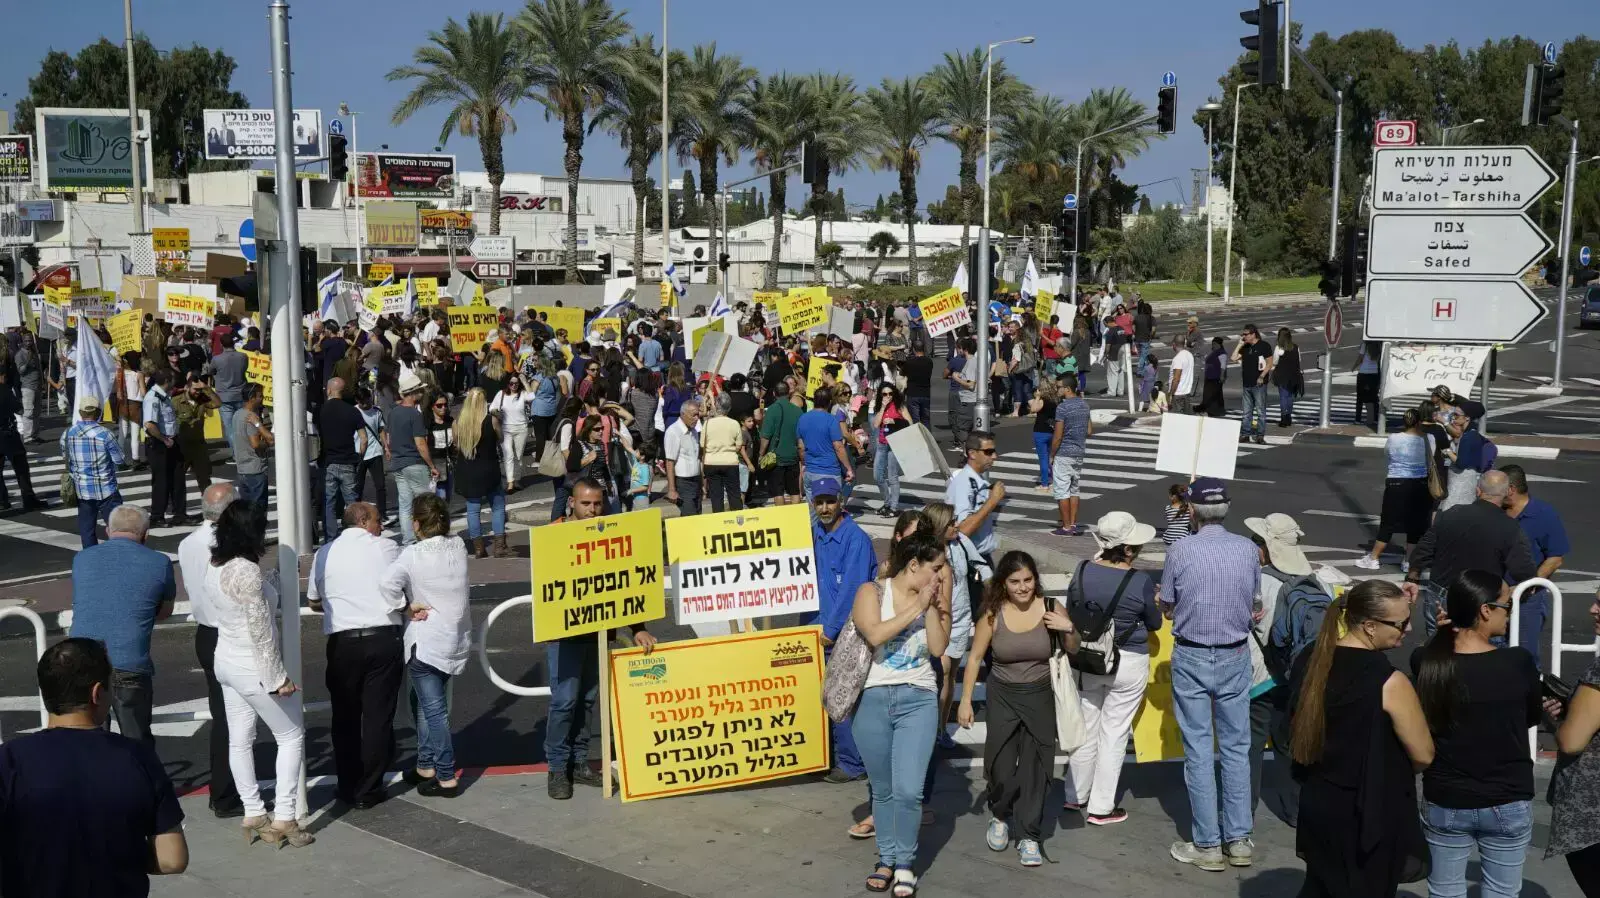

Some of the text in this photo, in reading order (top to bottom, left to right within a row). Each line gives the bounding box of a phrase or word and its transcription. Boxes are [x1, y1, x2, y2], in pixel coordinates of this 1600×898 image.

[252, 112, 270, 120] טופ
[1386, 128, 1404, 138] 89
[1395, 154, 1512, 168] מעלות תרשיחא
[1401, 172, 1504, 186] معلوت ترشيحا
[1434, 222, 1464, 232] צפת
[1427, 240, 1468, 250] تسفات
[1424, 256, 1470, 268] Safed
[168, 298, 204, 310] אין הטבה
[924, 292, 960, 316] אין הטבה
[168, 311, 202, 324] אין נהריה
[448, 314, 469, 328] צפון
[782, 304, 823, 324] אל תפסיקו לנו
[928, 309, 967, 334] אין נהריה
[792, 316, 820, 330] את החמצן
[452, 332, 476, 344] שקוף
[976, 418, 982, 427] 3
[570, 534, 632, 566] נהריה:
[702, 528, 782, 556] הטבות!
[682, 556, 811, 588] או לא להיות
[542, 565, 656, 602] אל תפסיקו לנו
[682, 582, 814, 614] לא לקיצוץ הטבות המס בנהריה
[564, 595, 645, 631] את החמצן
[628, 656, 666, 667] ההסתדרות
[645, 674, 798, 705] ההסתדרות ונעמת
[650, 694, 795, 723] מרחב גליל מערבי
[654, 709, 796, 746] לא ניתן לפגוע
[646, 730, 806, 766] בציבור העובדים
[657, 752, 798, 785] בגליל המערבי
